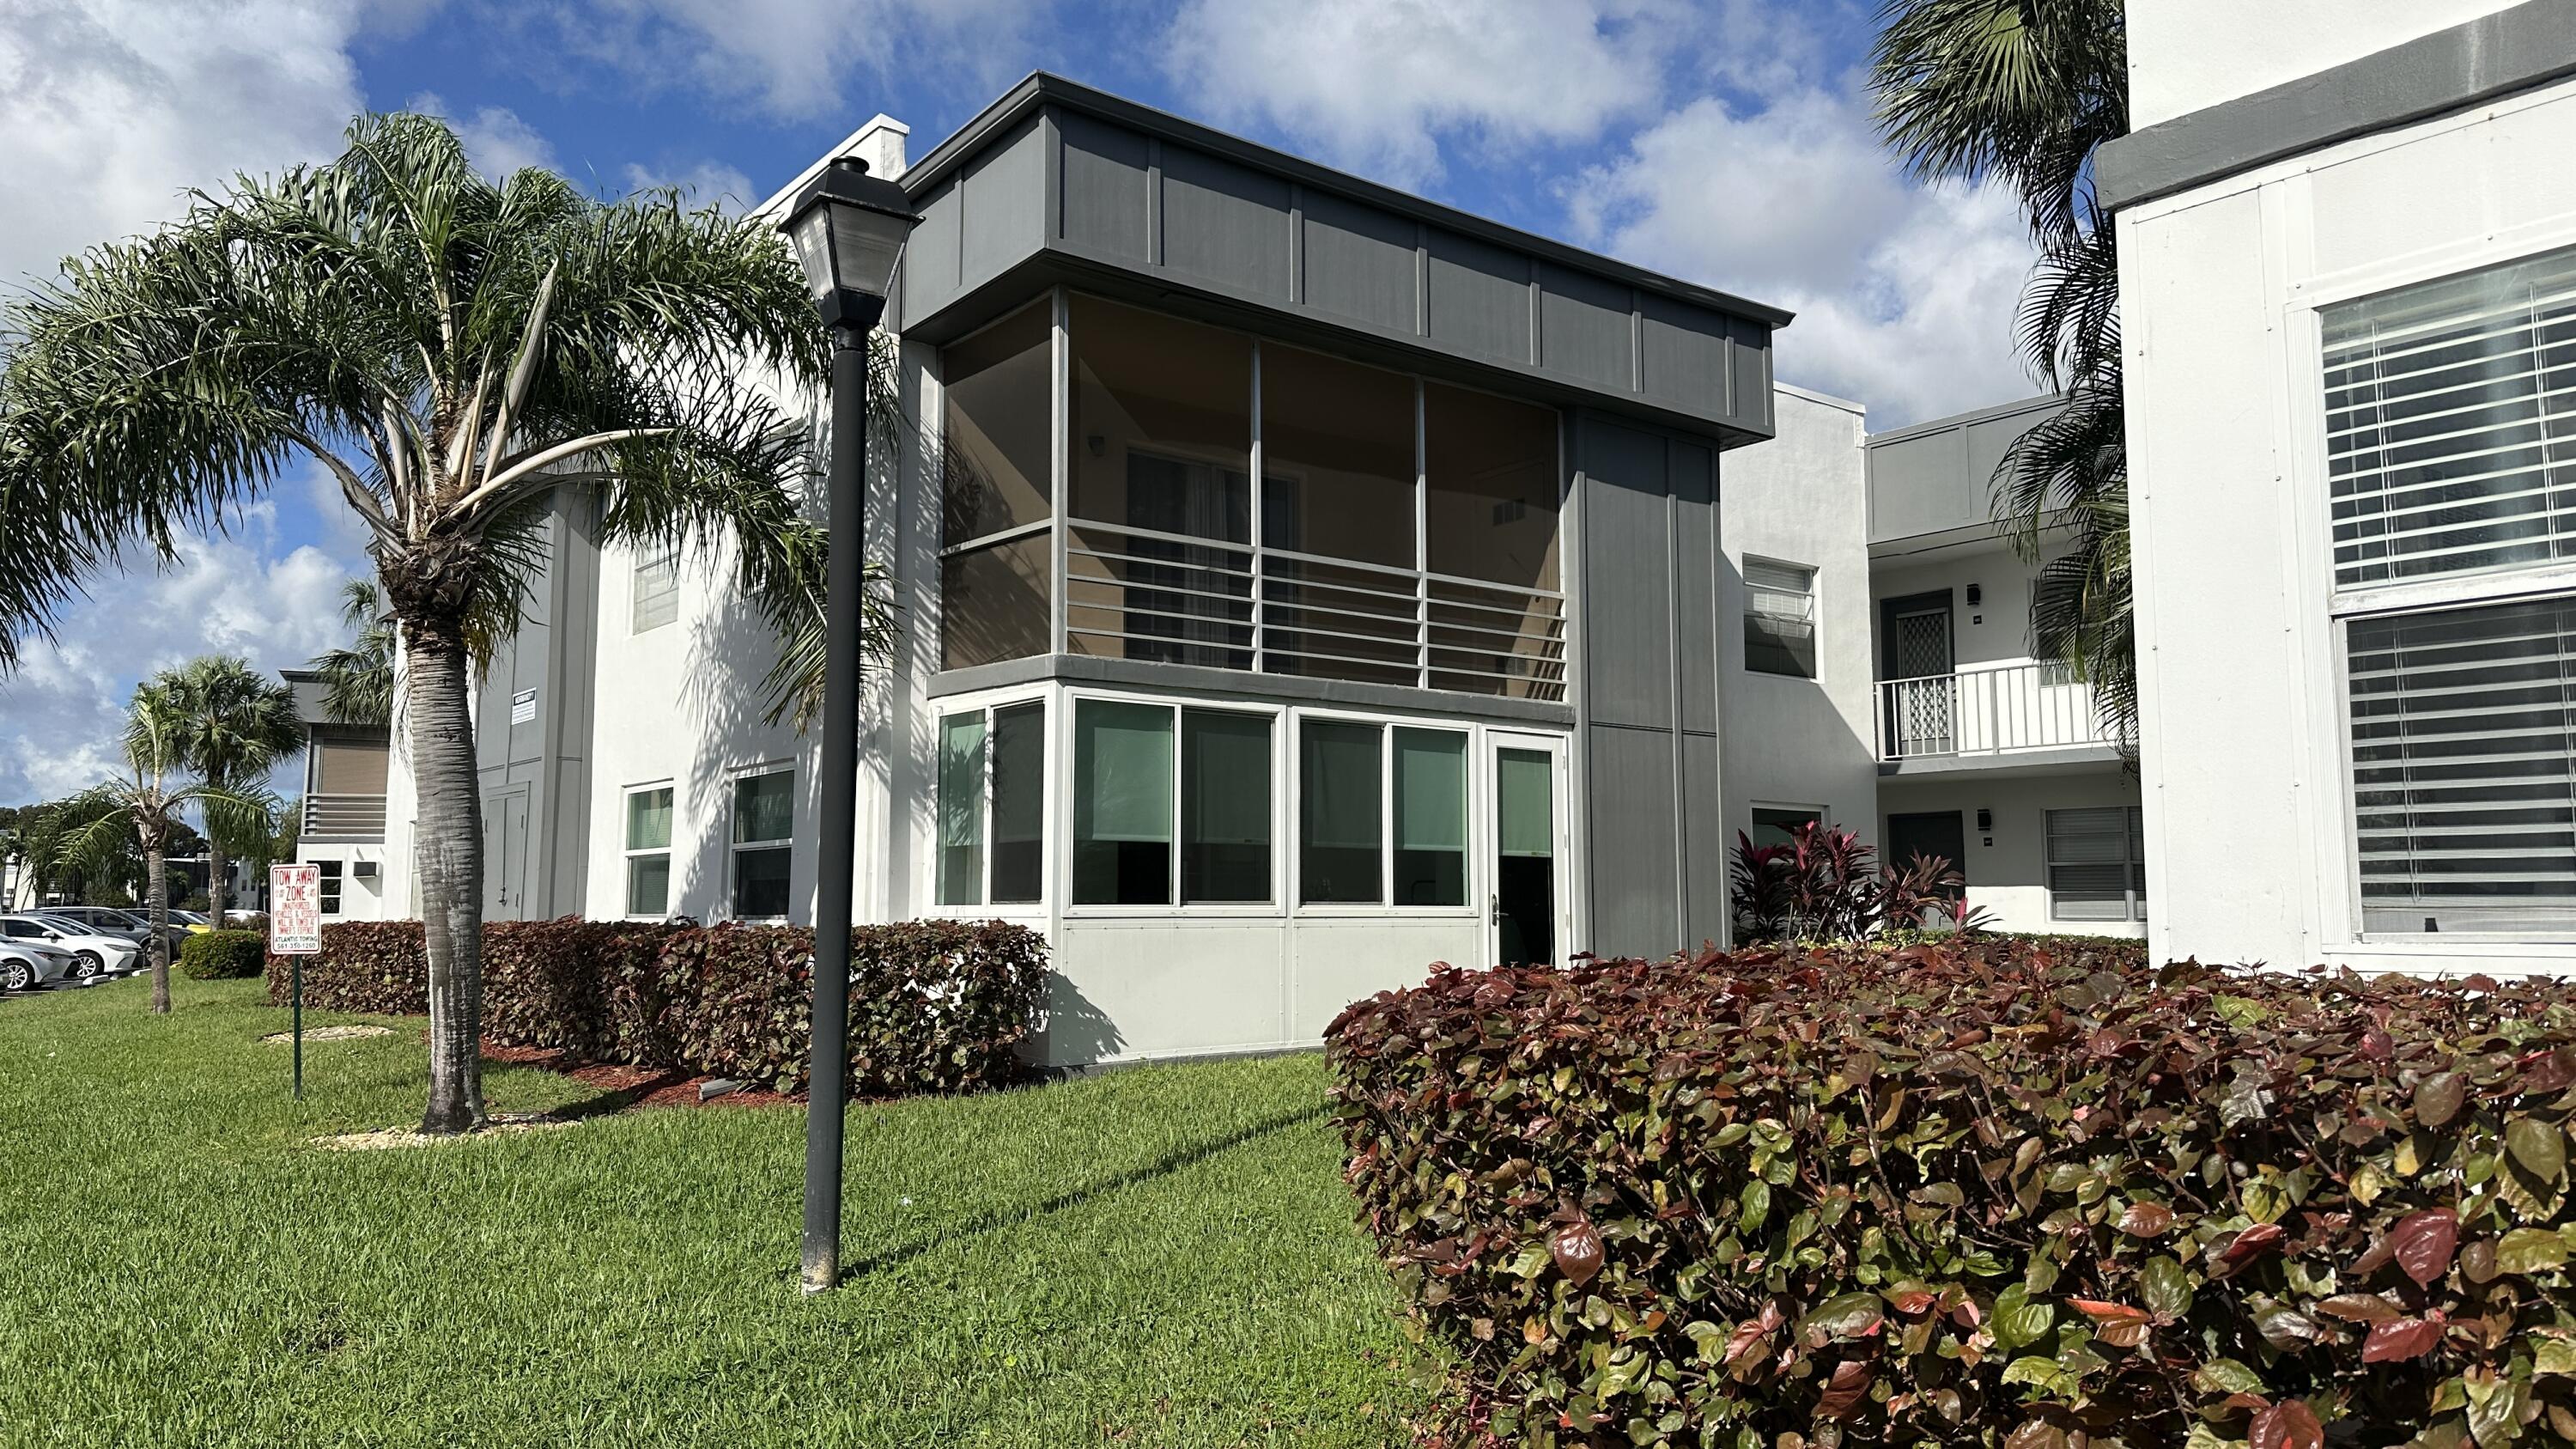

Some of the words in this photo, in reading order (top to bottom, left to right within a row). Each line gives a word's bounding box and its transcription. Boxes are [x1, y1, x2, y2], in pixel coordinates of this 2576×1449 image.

[275, 870, 291, 886] TOW
[295, 869, 316, 885] AWAY
[286, 886, 306, 901] ZONE
